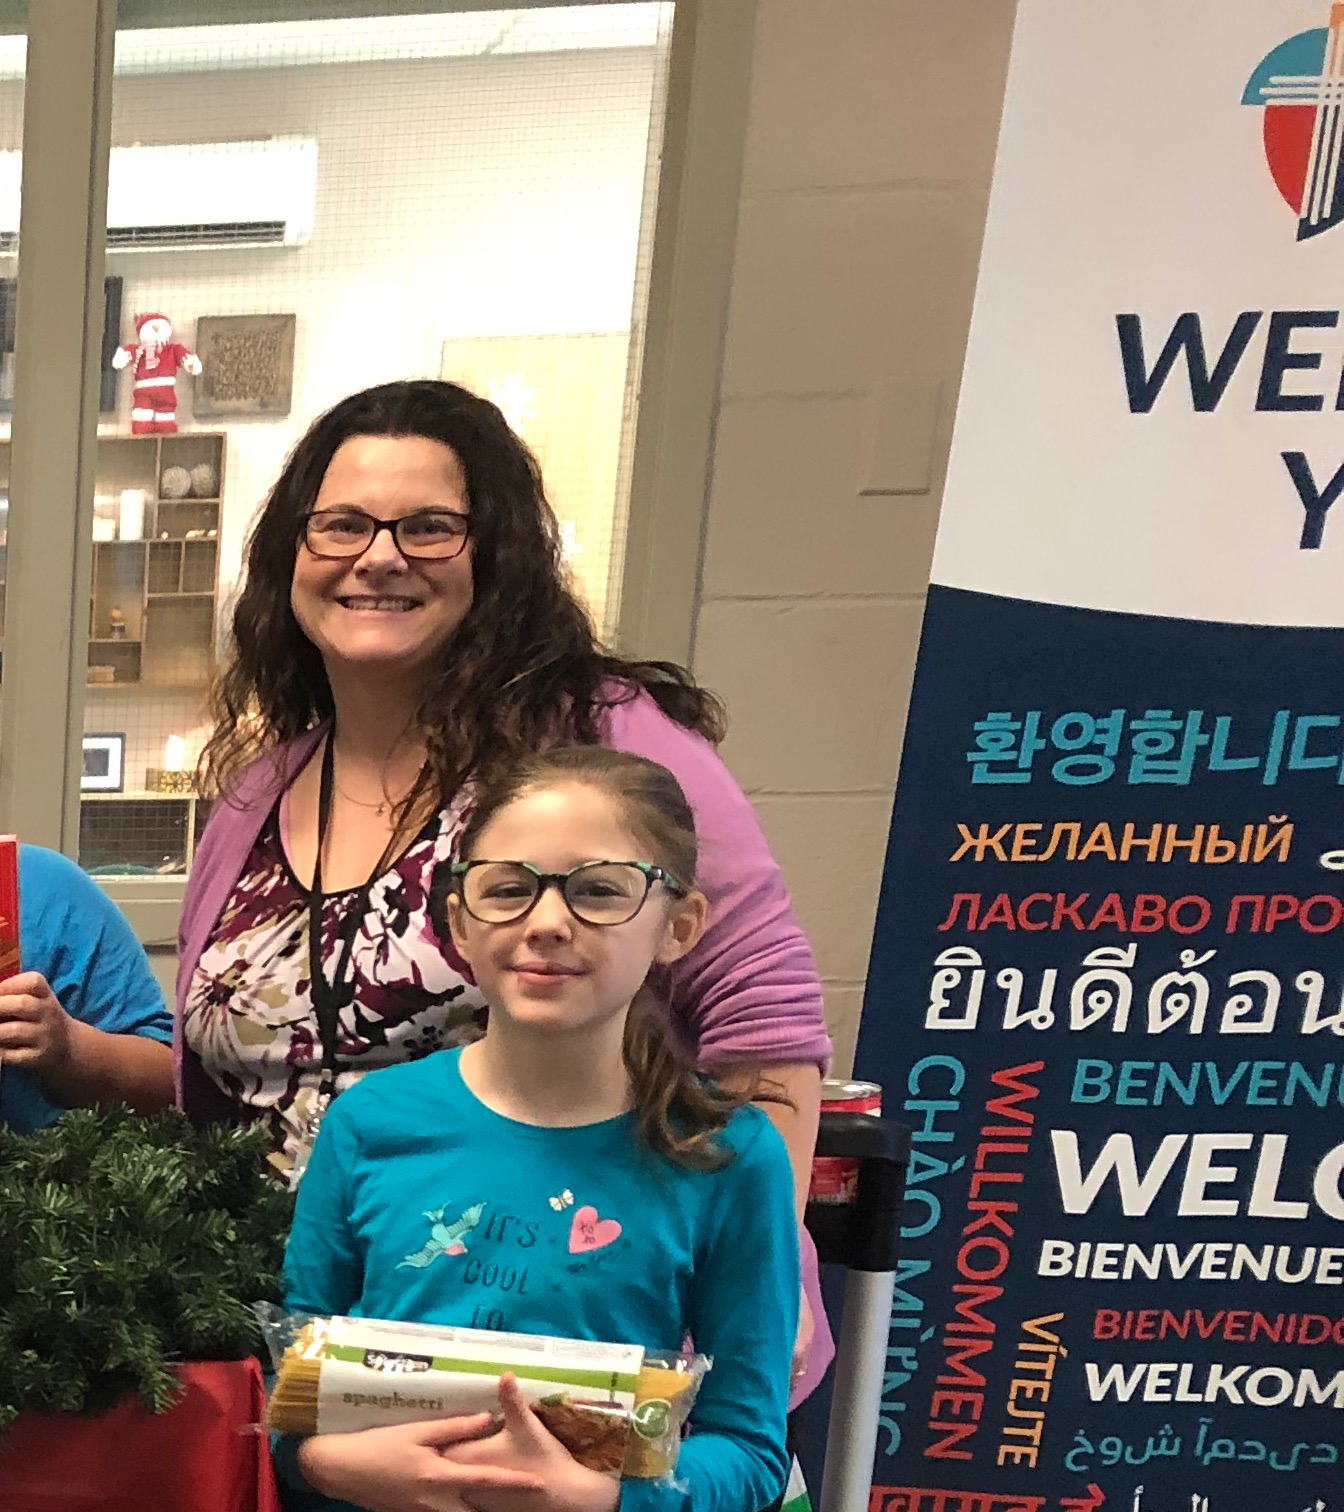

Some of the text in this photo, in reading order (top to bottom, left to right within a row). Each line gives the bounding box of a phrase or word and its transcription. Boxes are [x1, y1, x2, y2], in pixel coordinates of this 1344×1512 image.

[1115, 310, 1344, 414] WE
[949, 813, 1295, 864] ЖЕЛАННЫЙ
[937, 892, 1211, 935] ЛАСКАВО
[1070, 1058, 1344, 1108] BENVEN
[484, 1211, 540, 1248] IT'S
[463, 1258, 529, 1295] COOL
[923, 1060, 1045, 1461] WILLKOMMEN
[1037, 1239, 1344, 1285] BIENVENUE
[343, 1391, 444, 1410] spaghetti
[996, 1312, 1069, 1469] VÍTEJTE
[1085, 1362, 1344, 1409] WELKOM
